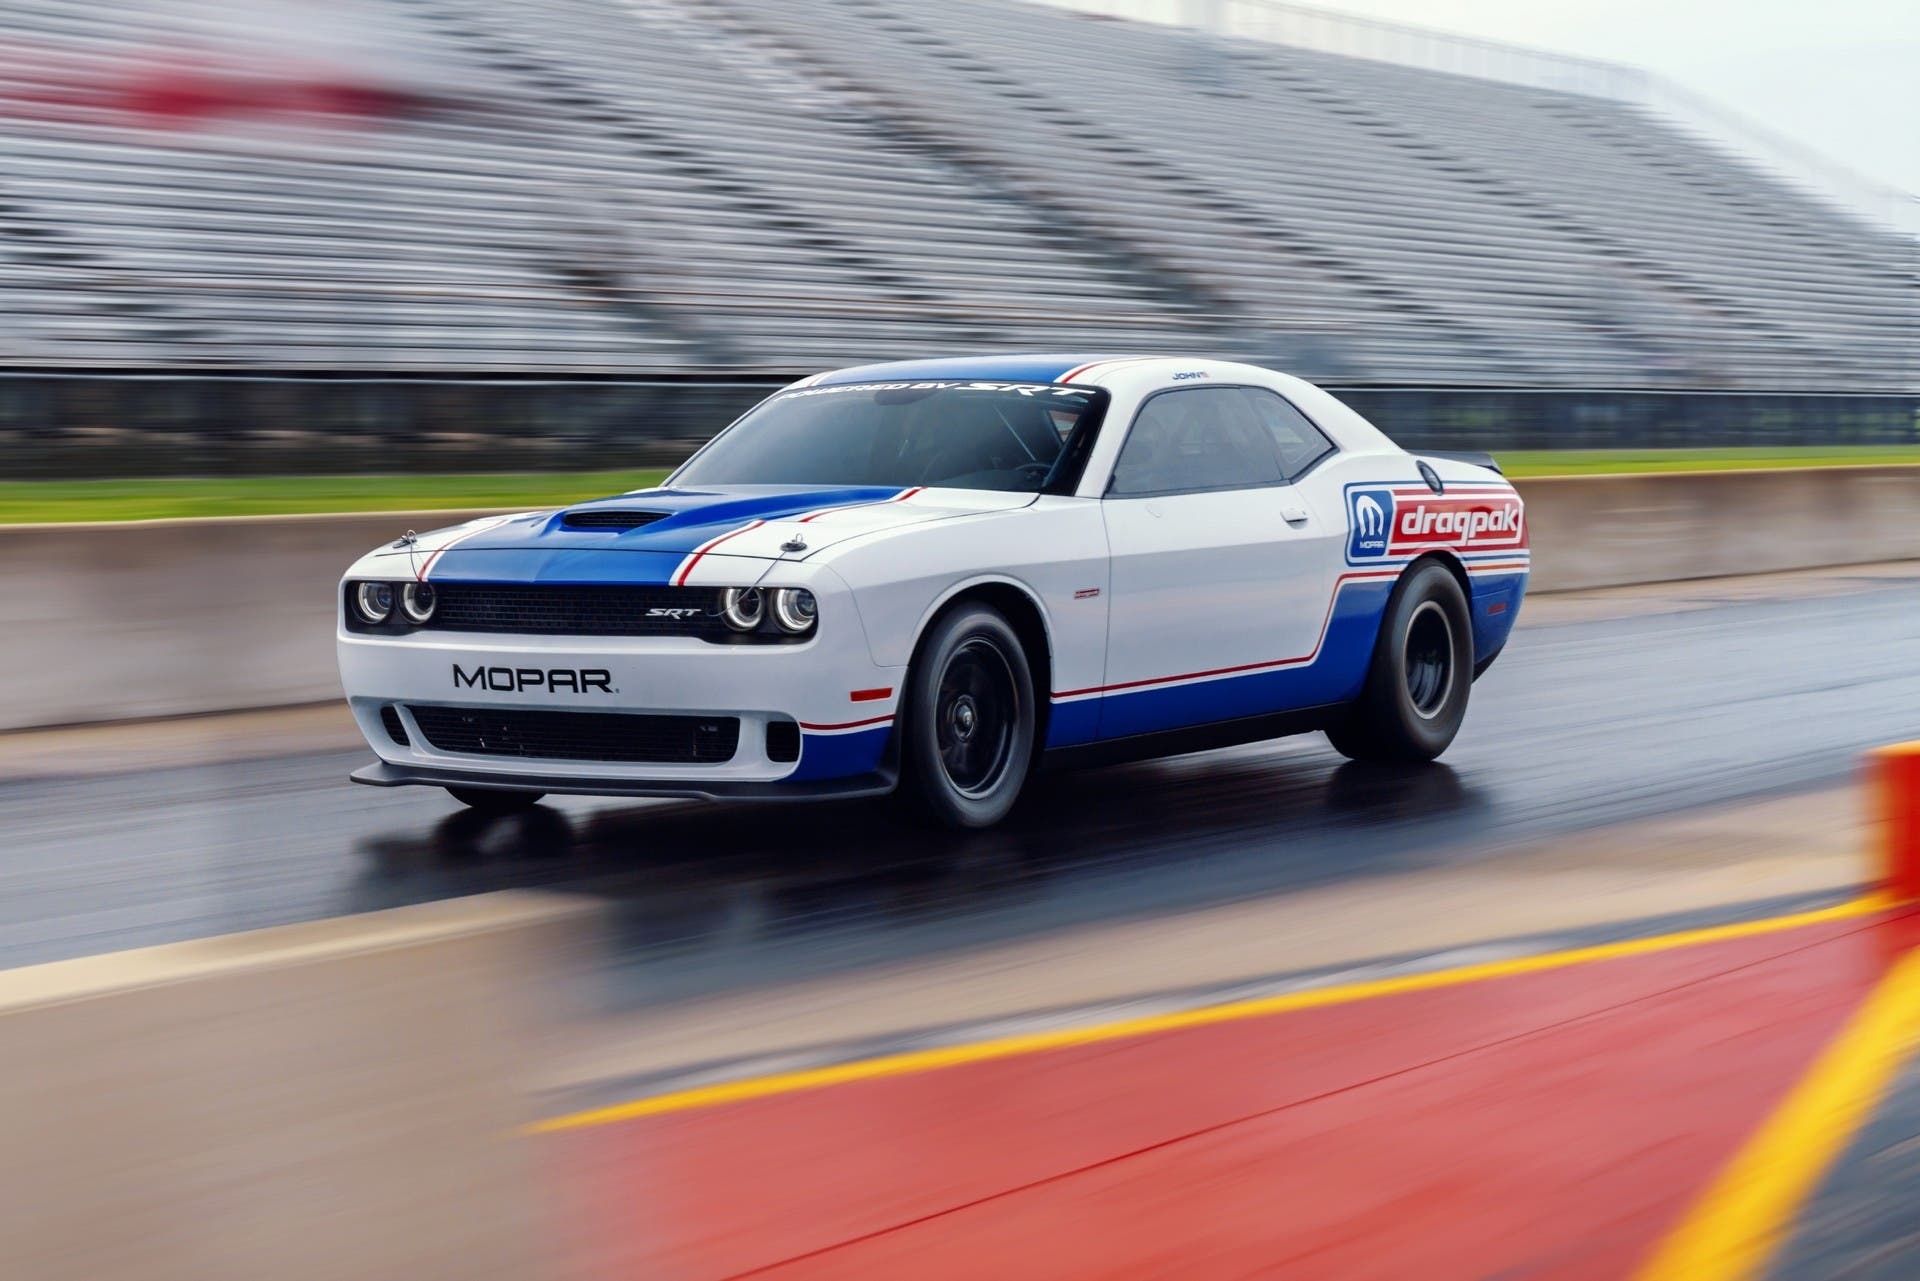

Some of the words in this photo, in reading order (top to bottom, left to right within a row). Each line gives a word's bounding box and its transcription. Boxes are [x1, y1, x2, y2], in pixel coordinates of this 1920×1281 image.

[954, 382, 1096, 396] SRT
[1401, 503, 1518, 545] dragpak
[645, 608, 702, 620] SRT
[452, 663, 614, 693] MOPAR
